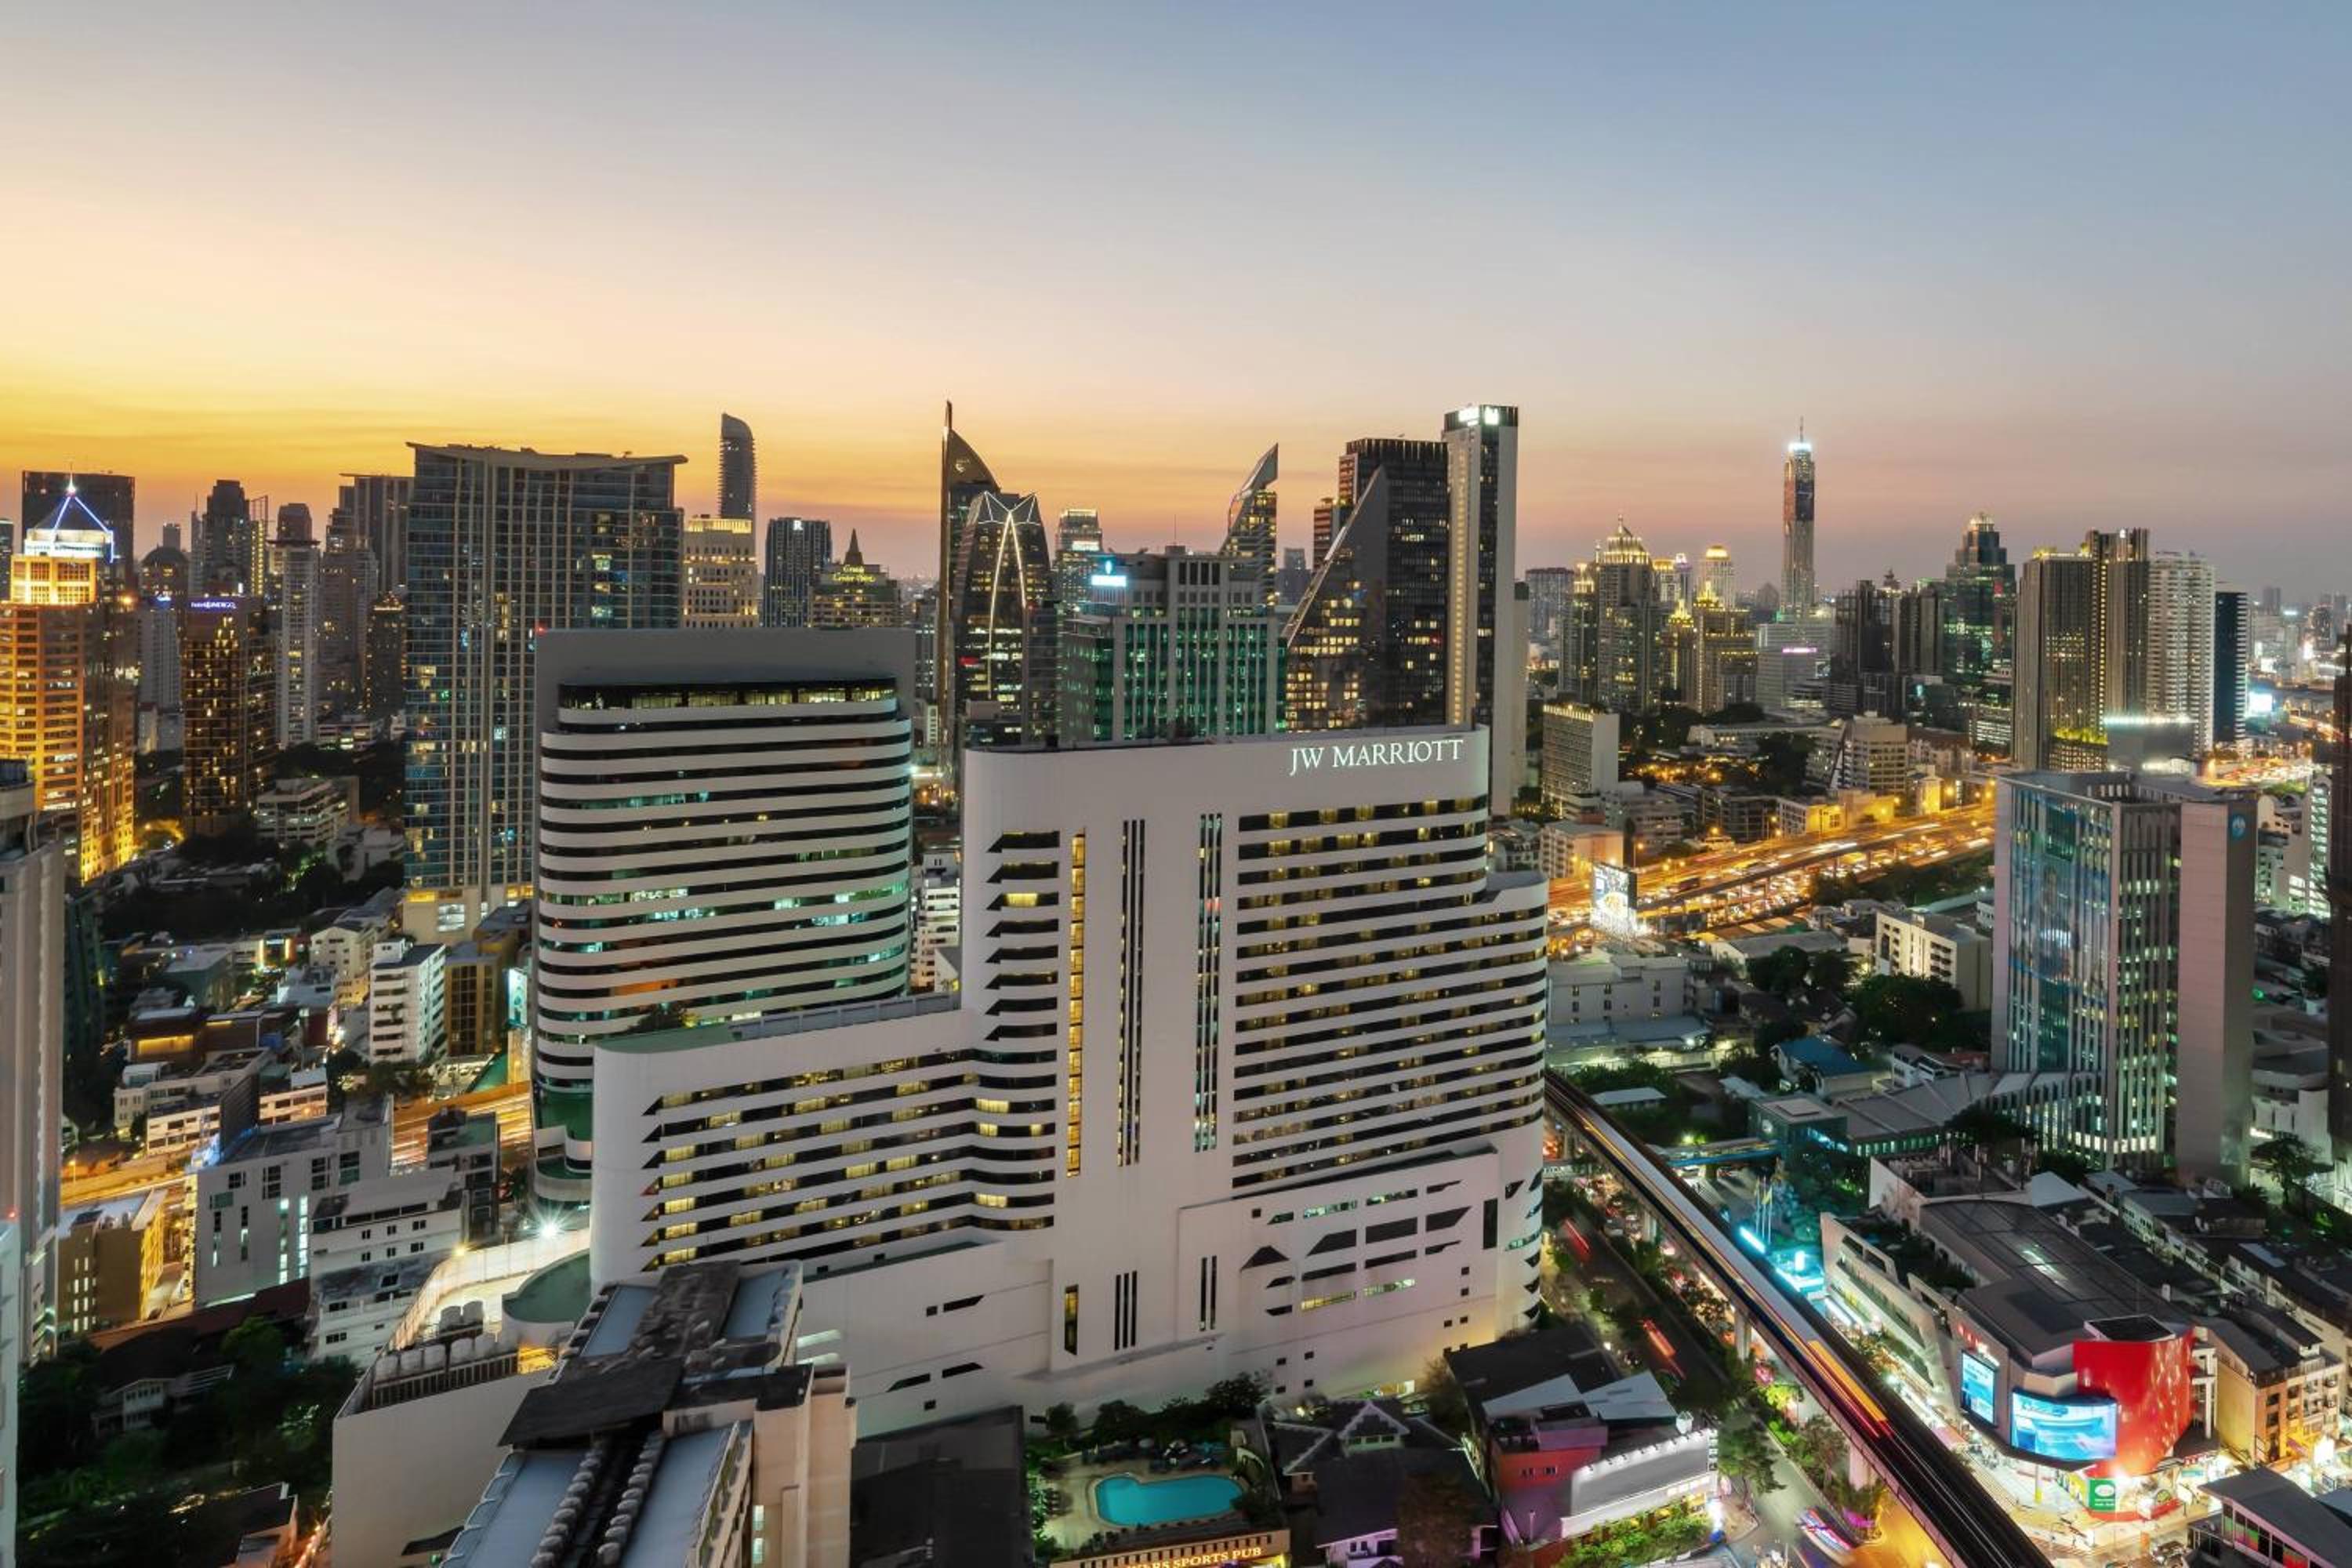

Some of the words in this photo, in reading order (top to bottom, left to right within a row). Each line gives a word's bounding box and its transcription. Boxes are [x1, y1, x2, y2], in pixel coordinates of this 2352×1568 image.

[1289, 747, 1325, 776] JW
[1332, 739, 1464, 768] MARRIOTT
[1173, 1552, 1229, 1568] SPORTS
[1232, 1547, 1261, 1559] PUB
